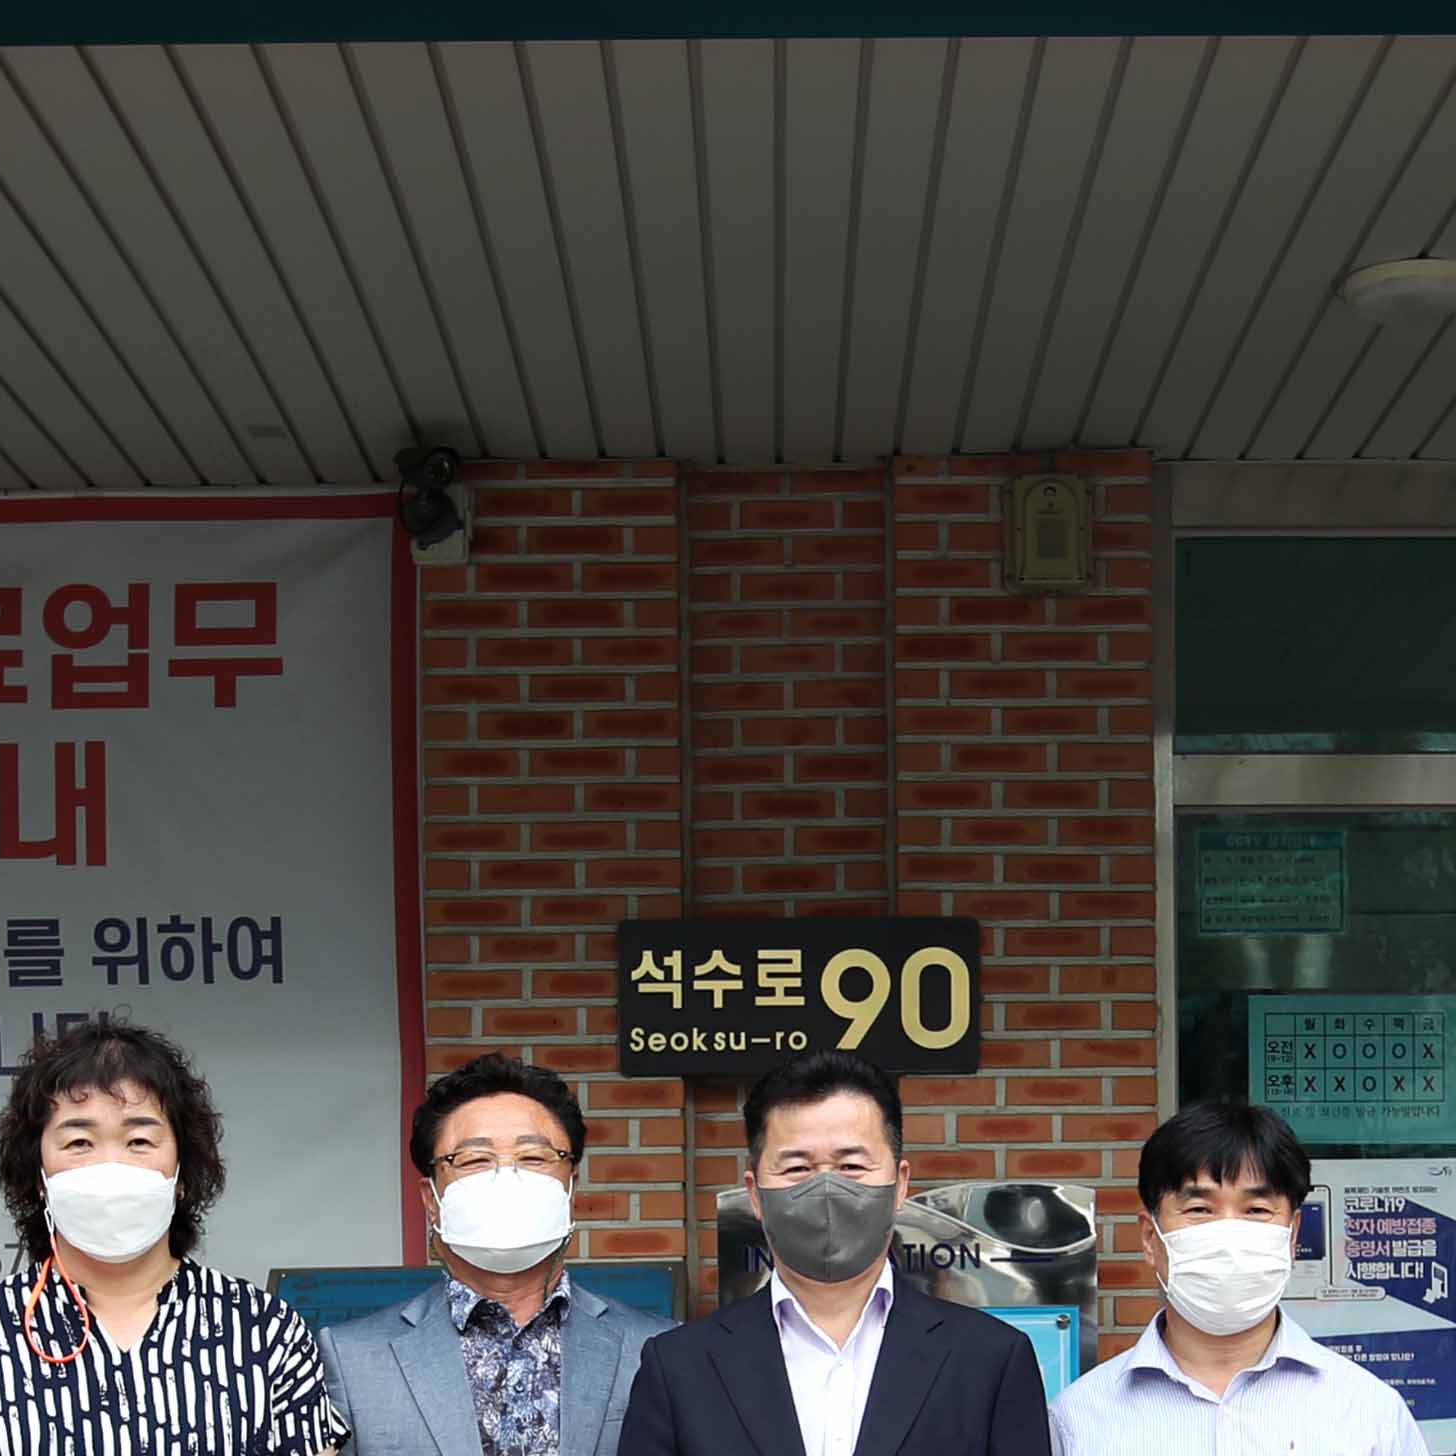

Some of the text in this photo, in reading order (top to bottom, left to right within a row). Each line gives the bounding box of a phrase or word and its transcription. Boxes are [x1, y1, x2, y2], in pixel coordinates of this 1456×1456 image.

[90, 915, 285, 985] 위하여
[631, 947, 970, 1049] 석수로 90
[1364, 1018, 1375, 1030] 수
[630, 1027, 807, 1052] Seoksu-ro
[1268, 1041, 1294, 1054] 오전
[1305, 1043, 1315, 1059] X
[1423, 1044, 1434, 1059] X
[1268, 1075, 1294, 1087] 오후
[1305, 1076, 1316, 1092] X
[1334, 1076, 1345, 1091] X
[1394, 1077, 1405, 1091] X
[1423, 1077, 1434, 1091] X
[1345, 1196, 1405, 1212] 코로나19
[1346, 1218, 1436, 1236] 전자 예방접종
[1346, 1240, 1436, 1257] 증명서 발급을
[746, 1244, 981, 1273] INATION
[1347, 1262, 1424, 1279] 시행합니다!
